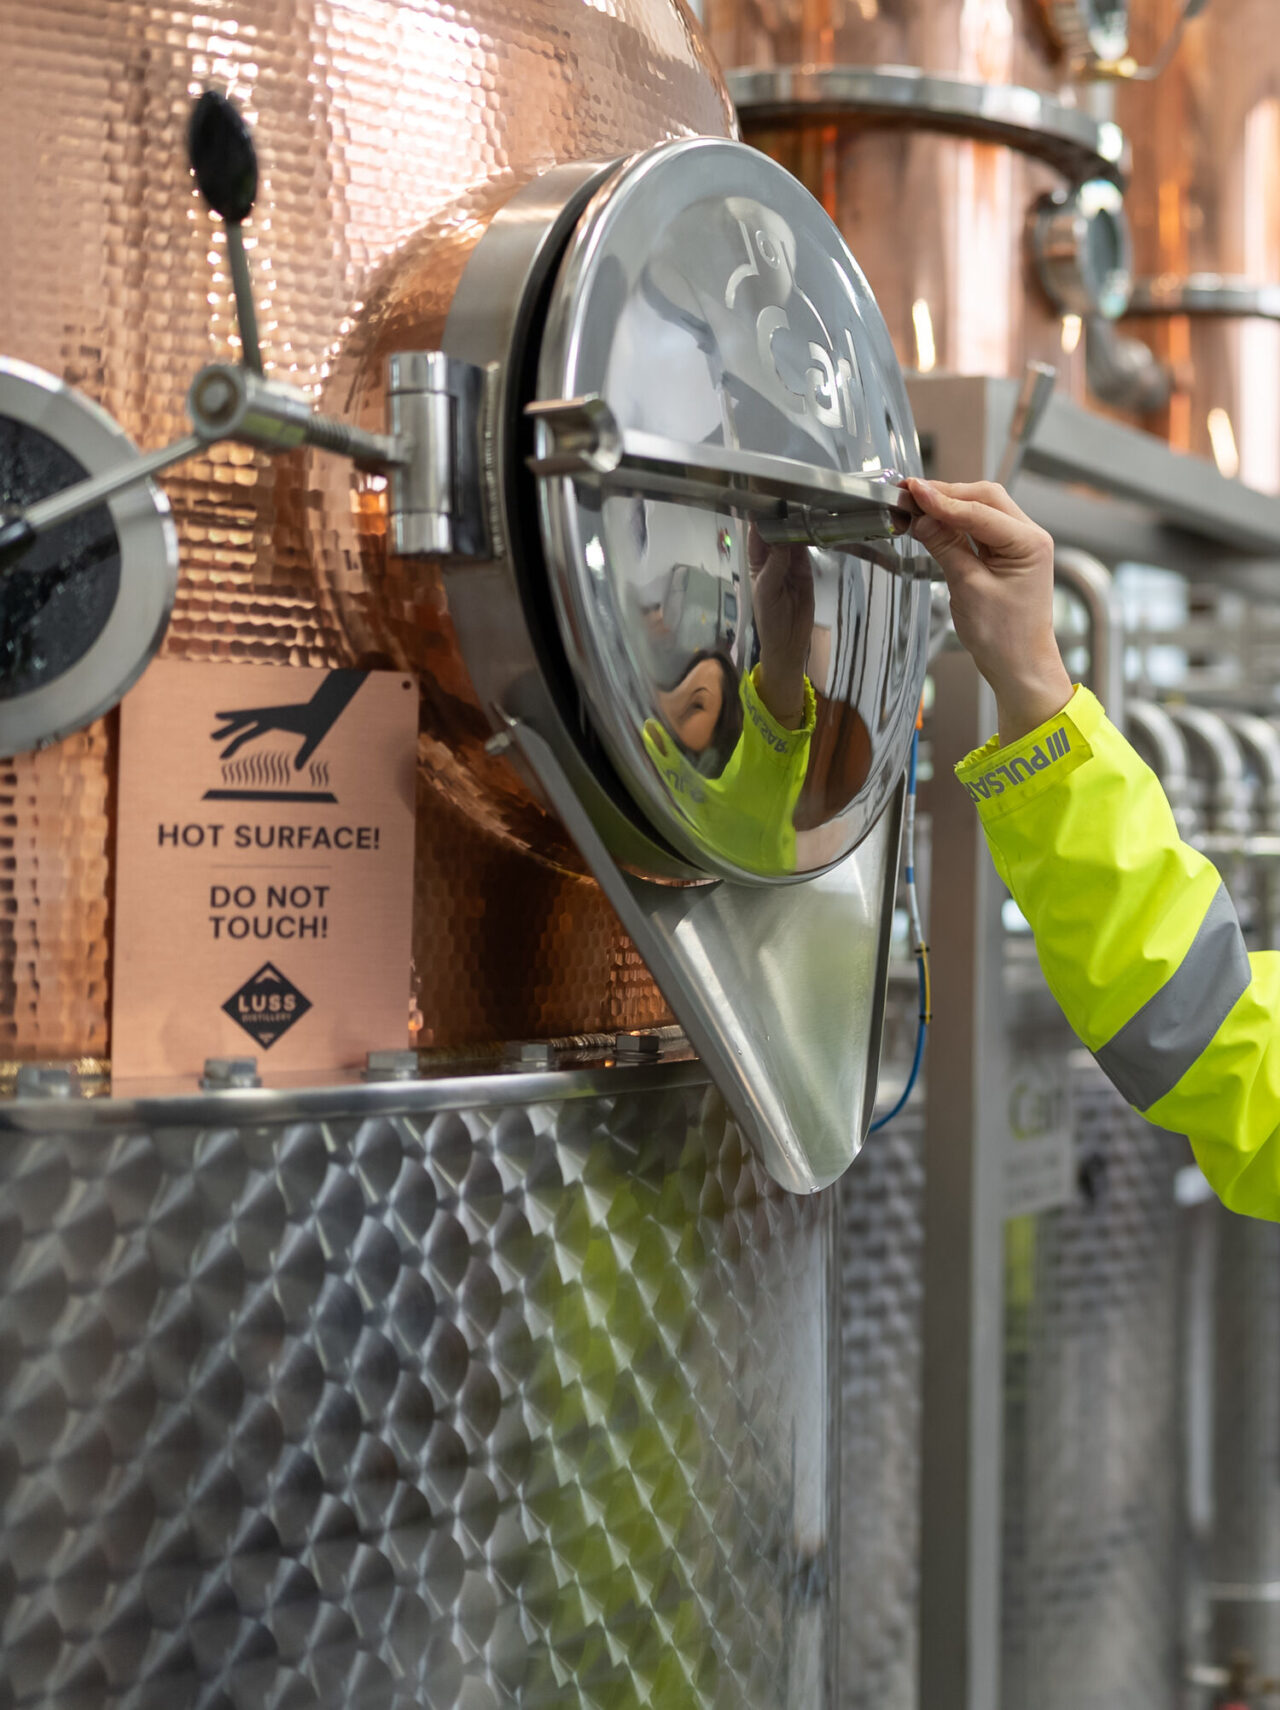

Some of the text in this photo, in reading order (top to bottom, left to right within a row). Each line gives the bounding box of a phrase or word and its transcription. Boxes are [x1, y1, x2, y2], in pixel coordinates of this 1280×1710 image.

[158, 824, 380, 850] HOT SURFACE!
[210, 886, 331, 909] DO NOT
[208, 916, 328, 940] TOUCH!
[238, 993, 297, 1013] LUSS
